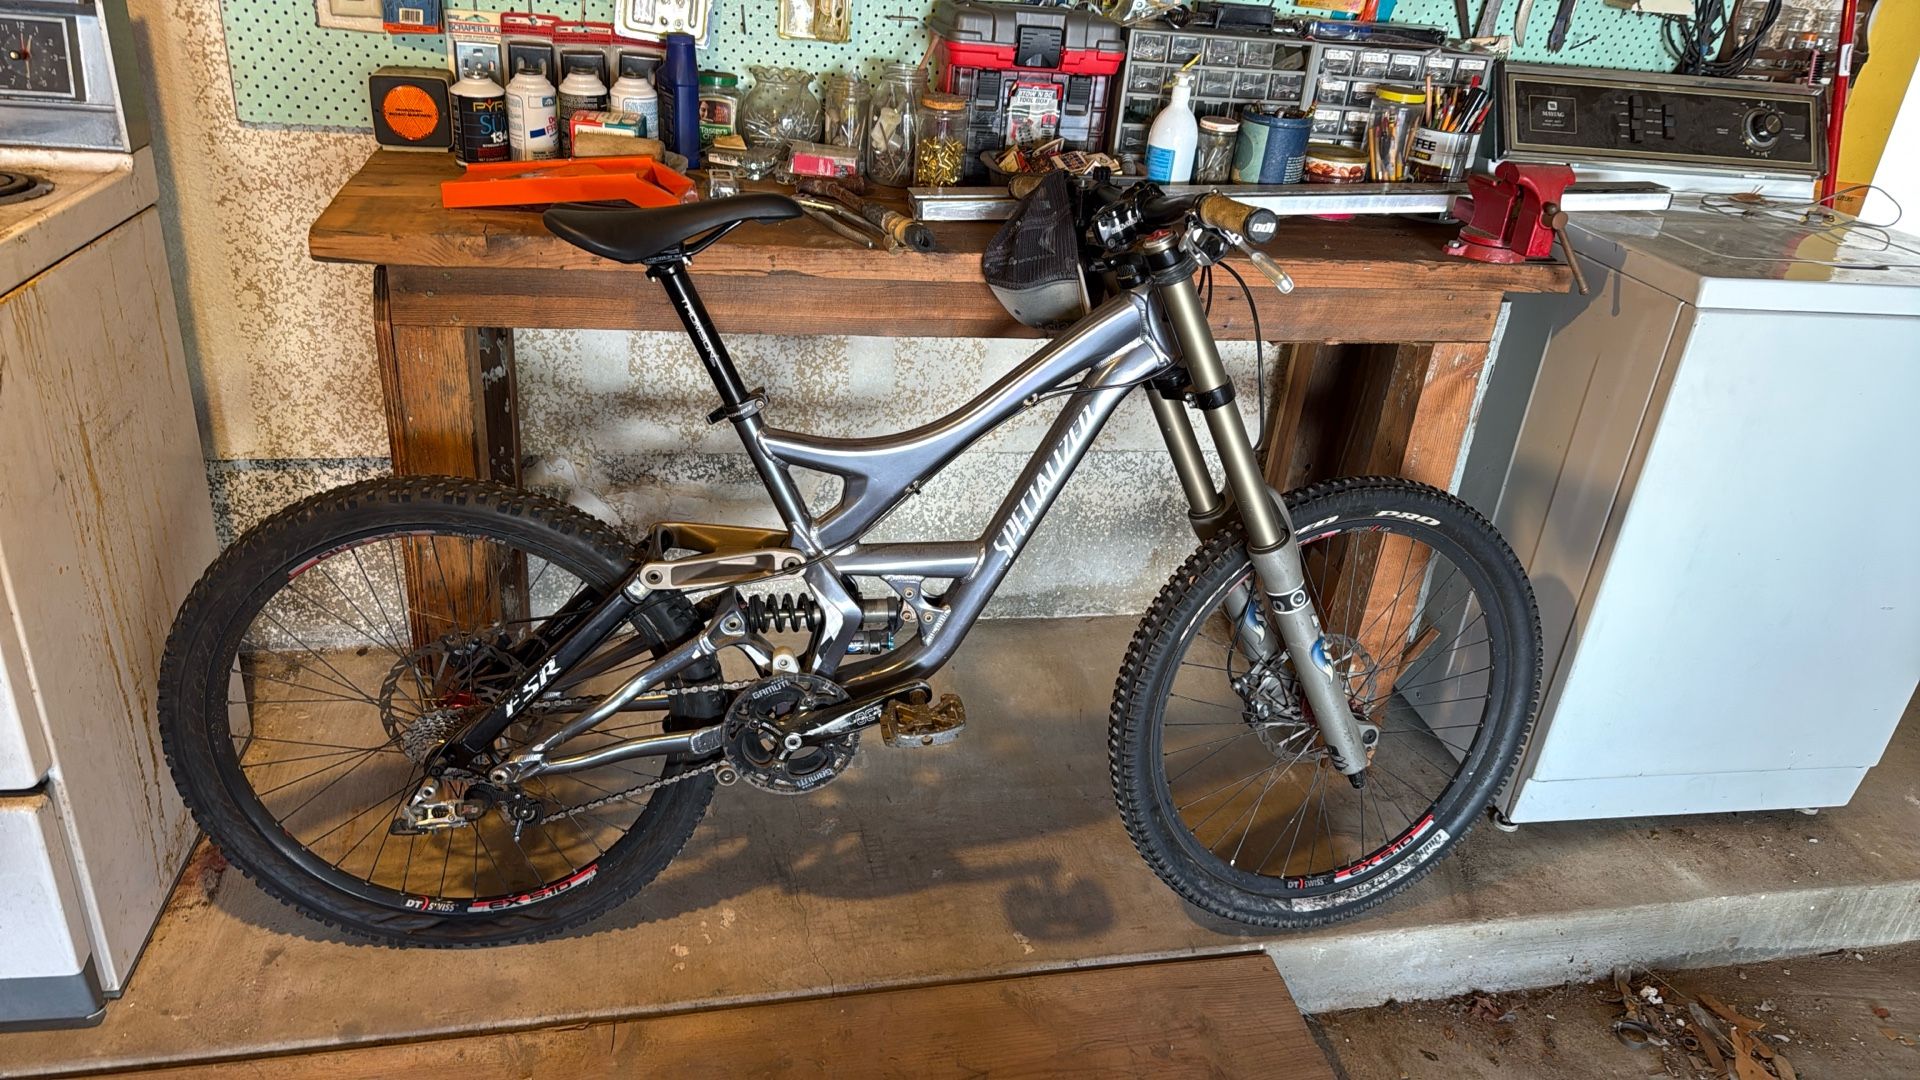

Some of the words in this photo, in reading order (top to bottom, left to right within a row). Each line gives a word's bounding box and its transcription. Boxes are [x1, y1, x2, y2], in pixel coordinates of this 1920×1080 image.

[16, 21, 25, 29] 12
[448, 23, 482, 32] SCRAPER
[48, 38, 54, 47] 2
[51, 68, 57, 76] 4
[26, 81, 33, 90] 6
[682, 297, 718, 360] THOMSON
[993, 404, 1097, 566] SPECIALIZED
[1375, 510, 1441, 526] PRO
[1349, 860, 1378, 876] EX
[1287, 881, 1300, 889] DT
[1304, 879, 1324, 888] SWISS
[405, 899, 422, 908] DT
[427, 901, 456, 912] SWISS
[488, 897, 525, 908] EX
